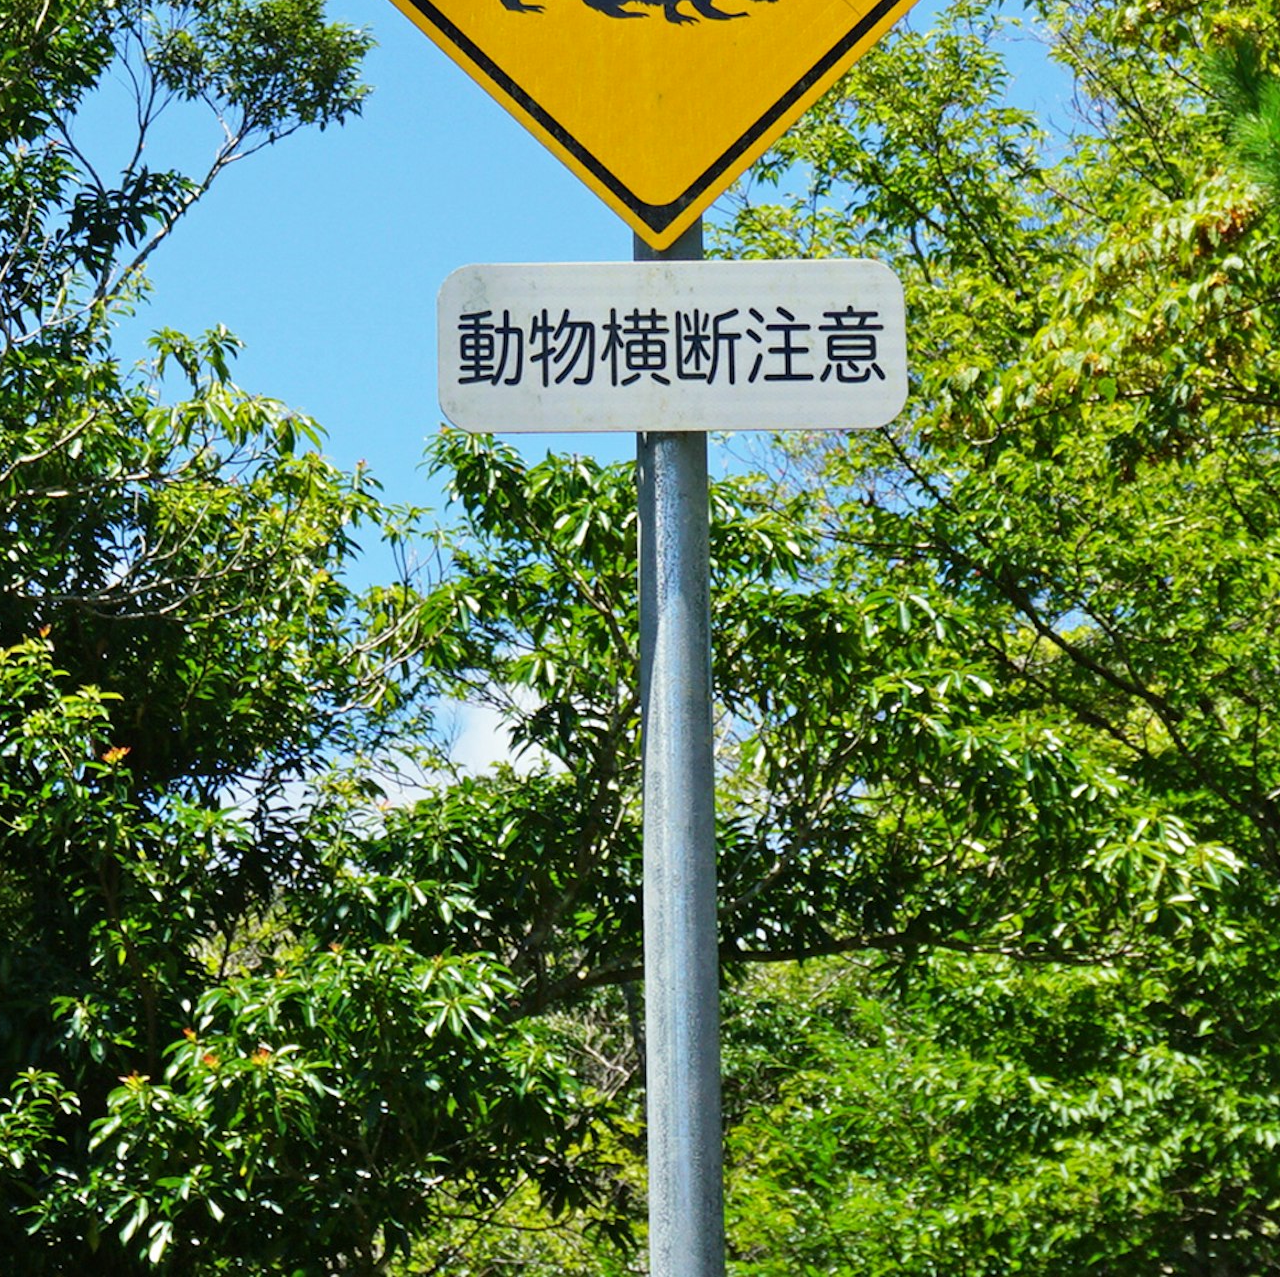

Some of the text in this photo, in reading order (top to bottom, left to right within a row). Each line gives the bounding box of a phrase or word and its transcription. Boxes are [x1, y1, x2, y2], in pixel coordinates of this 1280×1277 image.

[457, 305, 886, 388] 動物横断注意
